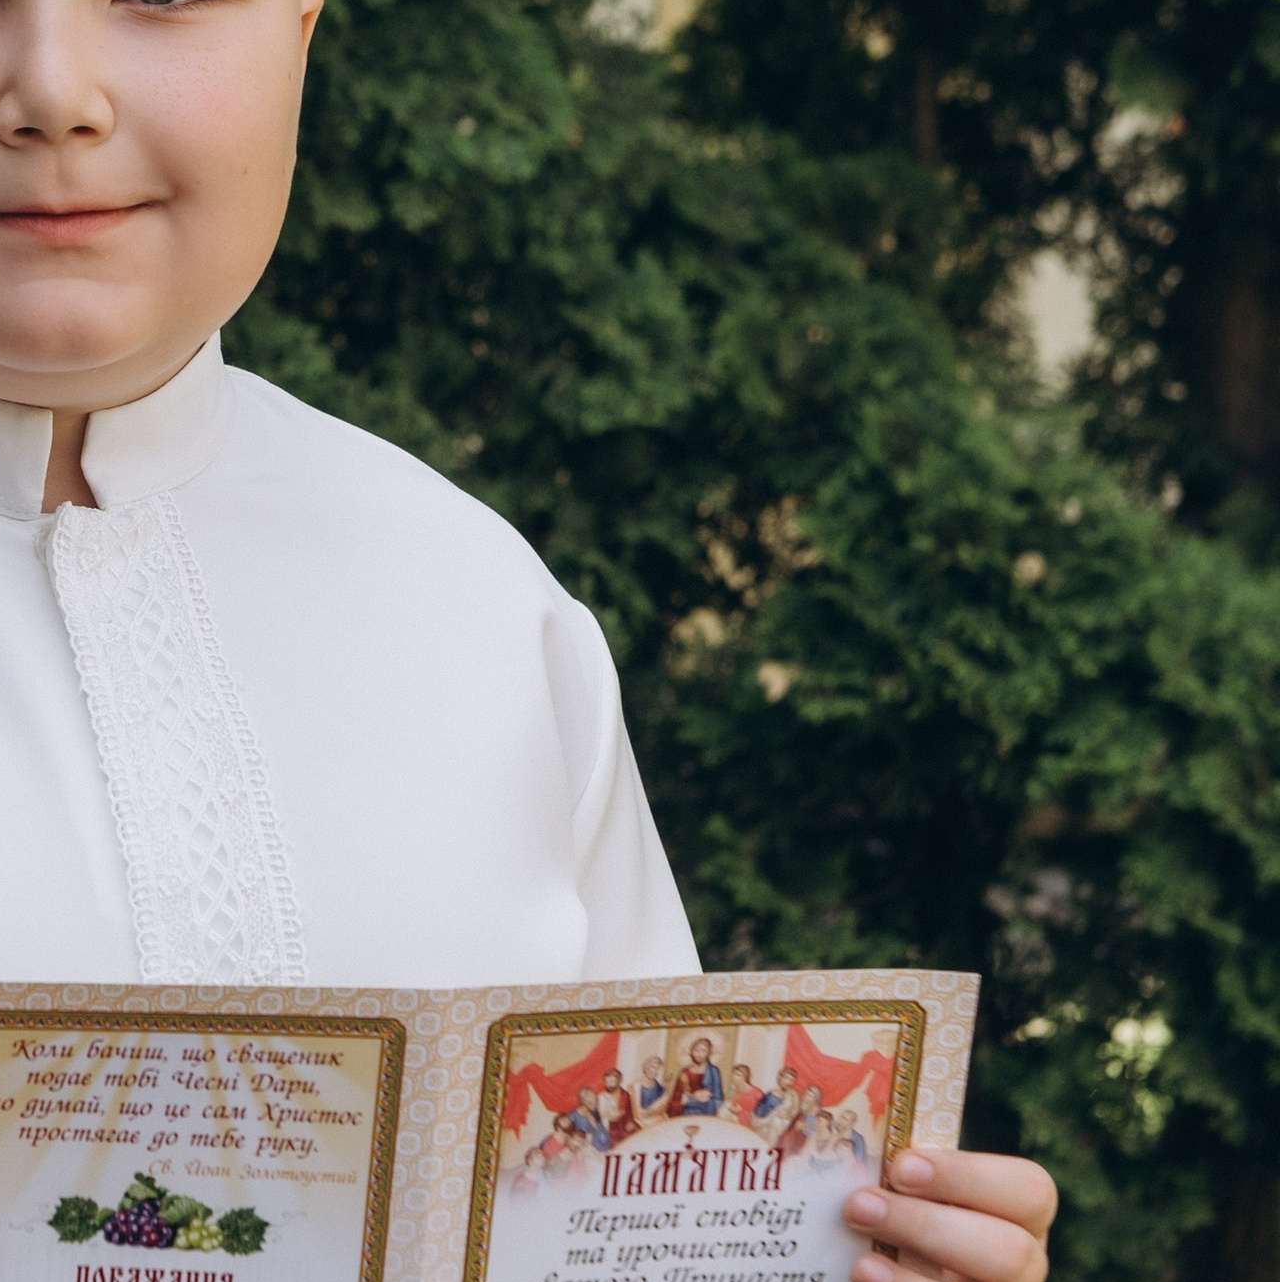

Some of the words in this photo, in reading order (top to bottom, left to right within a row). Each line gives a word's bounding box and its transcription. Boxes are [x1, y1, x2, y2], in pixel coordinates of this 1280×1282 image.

[12, 1038, 75, 1061] Коли
[86, 1037, 169, 1063] бачиш,
[181, 1047, 216, 1068] що
[226, 1042, 344, 1070] священик
[26, 1070, 93, 1093] подає
[104, 1067, 161, 1089] тобі
[171, 1071, 241, 1091] Чесні
[250, 1072, 321, 1100] Дари,
[19, 1094, 106, 1119] думай,
[119, 1101, 153, 1121] що
[164, 1102, 191, 1122] це
[201, 1104, 247, 1121] сам
[257, 1101, 364, 1129] Христос
[18, 1126, 141, 1148] простягає
[146, 1130, 180, 1153] до
[189, 1127, 246, 1150] тебе
[255, 1133, 319, 1158] руку.
[238, 1163, 359, 1188] Золотоустий
[565, 1203, 687, 1241] Першої
[695, 1198, 808, 1236] сповіді
[565, 1245, 605, 1268] та
[616, 1239, 798, 1273] урочистого
